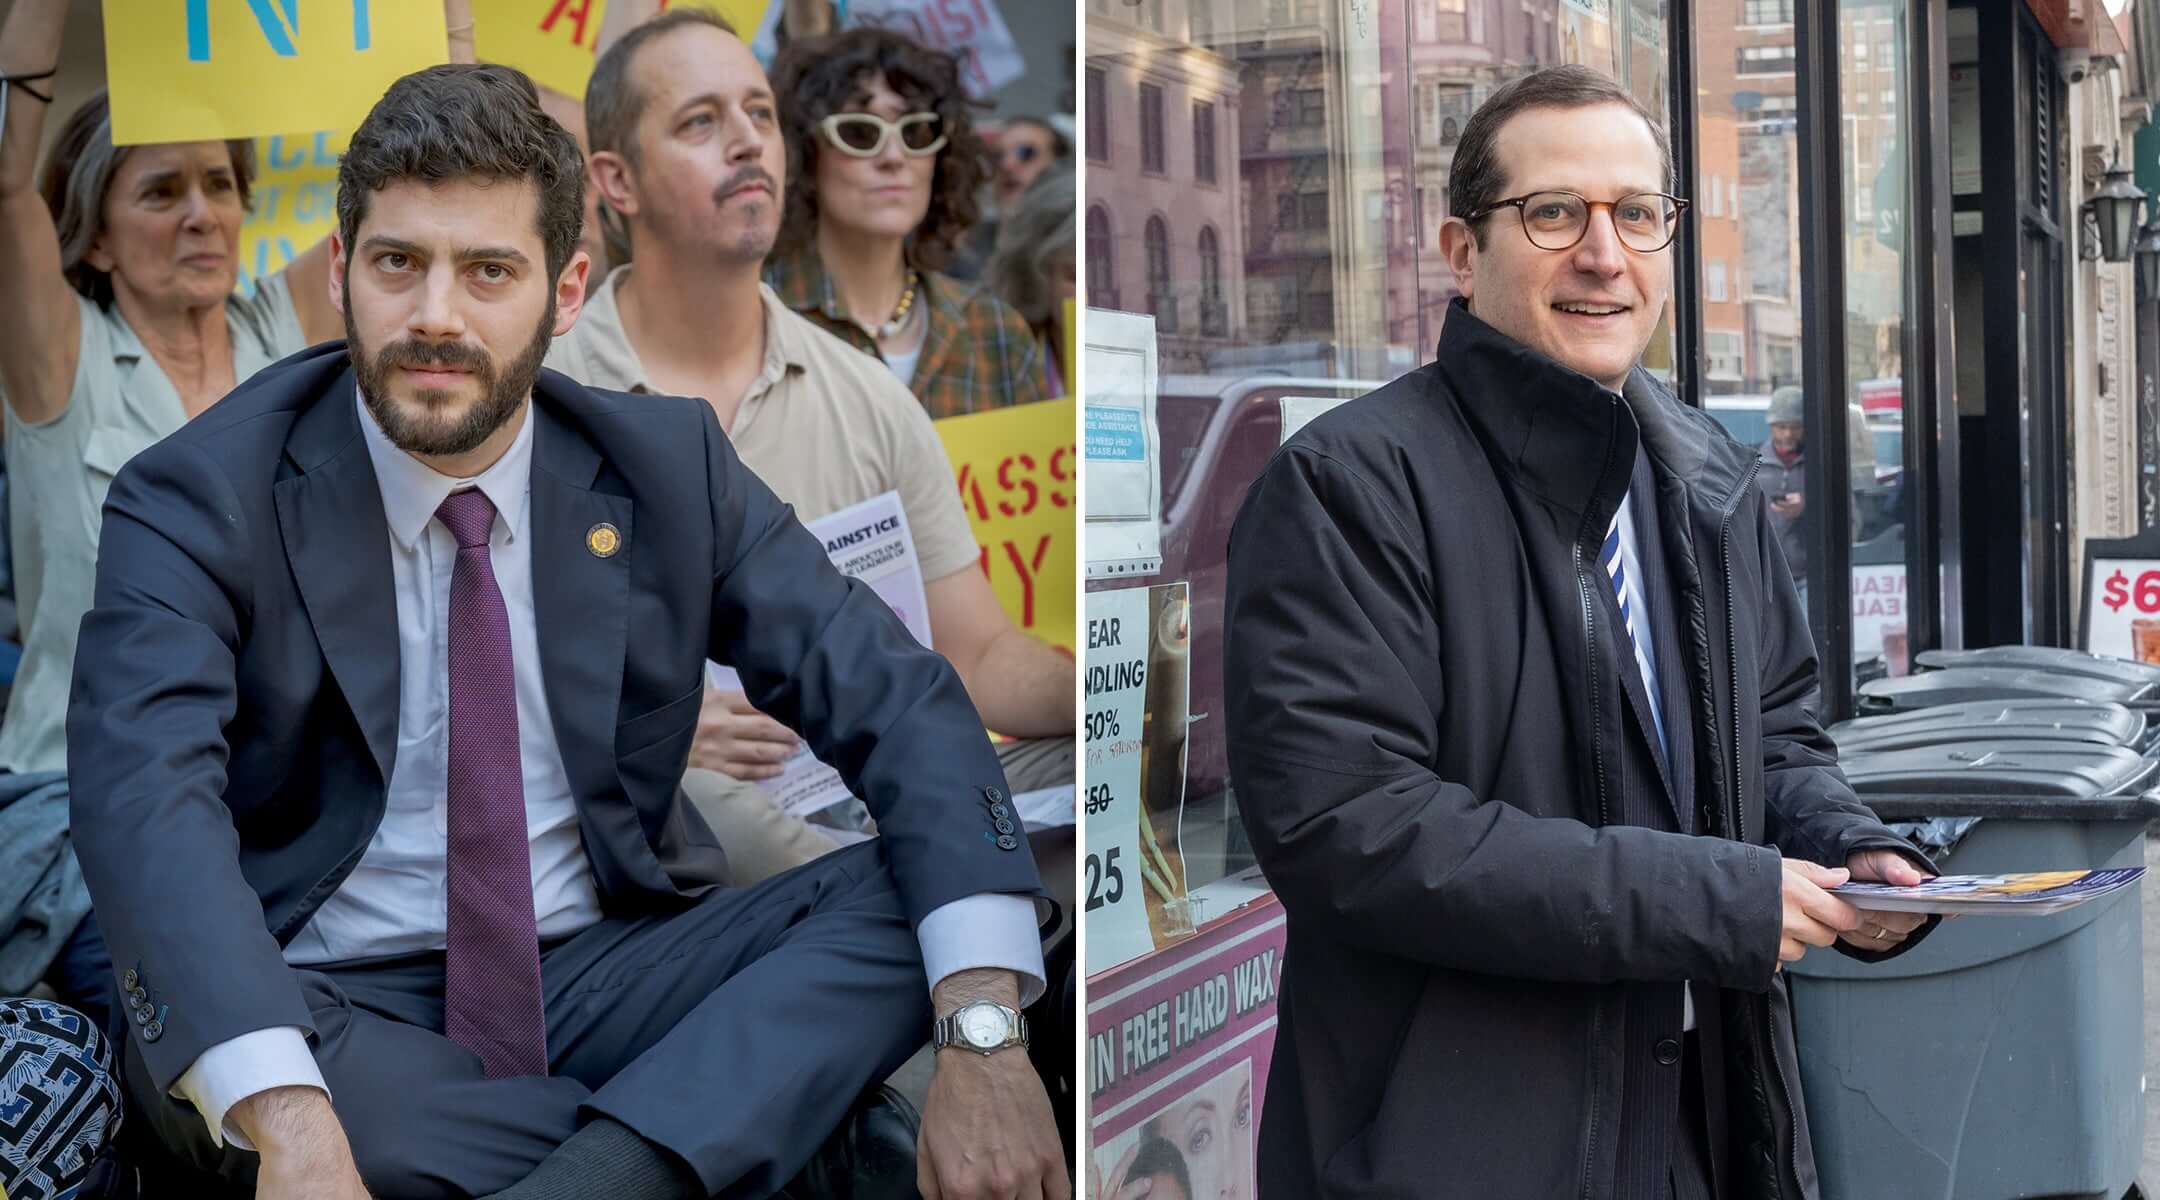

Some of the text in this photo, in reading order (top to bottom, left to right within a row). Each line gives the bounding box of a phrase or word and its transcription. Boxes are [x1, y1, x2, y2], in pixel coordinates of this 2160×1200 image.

[874, 515, 899, 535] ICE
[1088, 617, 1121, 649] EAR
[1085, 709, 1120, 742] 50%
[1085, 846, 1123, 913] 25
[1122, 1001, 1169, 1077] FREE
[1175, 974, 1229, 1049] HARD
[1233, 949, 1275, 1016] WAX
